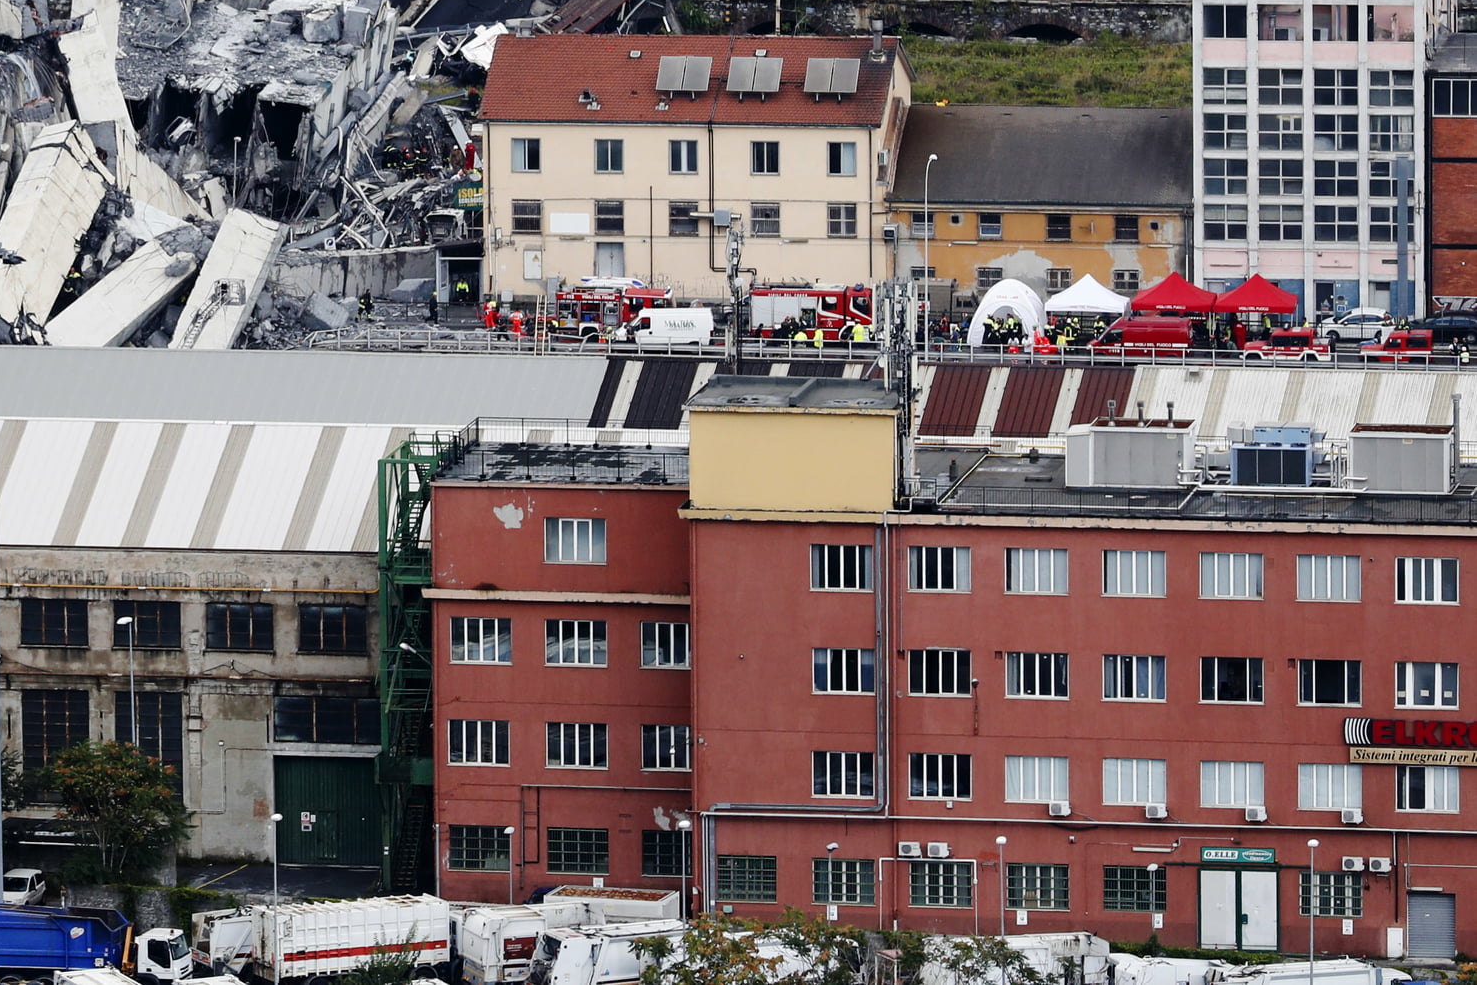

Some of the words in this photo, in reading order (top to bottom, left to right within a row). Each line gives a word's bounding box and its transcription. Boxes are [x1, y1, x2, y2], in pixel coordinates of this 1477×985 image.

[1354, 749, 1395, 760] Sistemi
[1399, 751, 1447, 764] integrati
[1449, 755, 1468, 764] per
